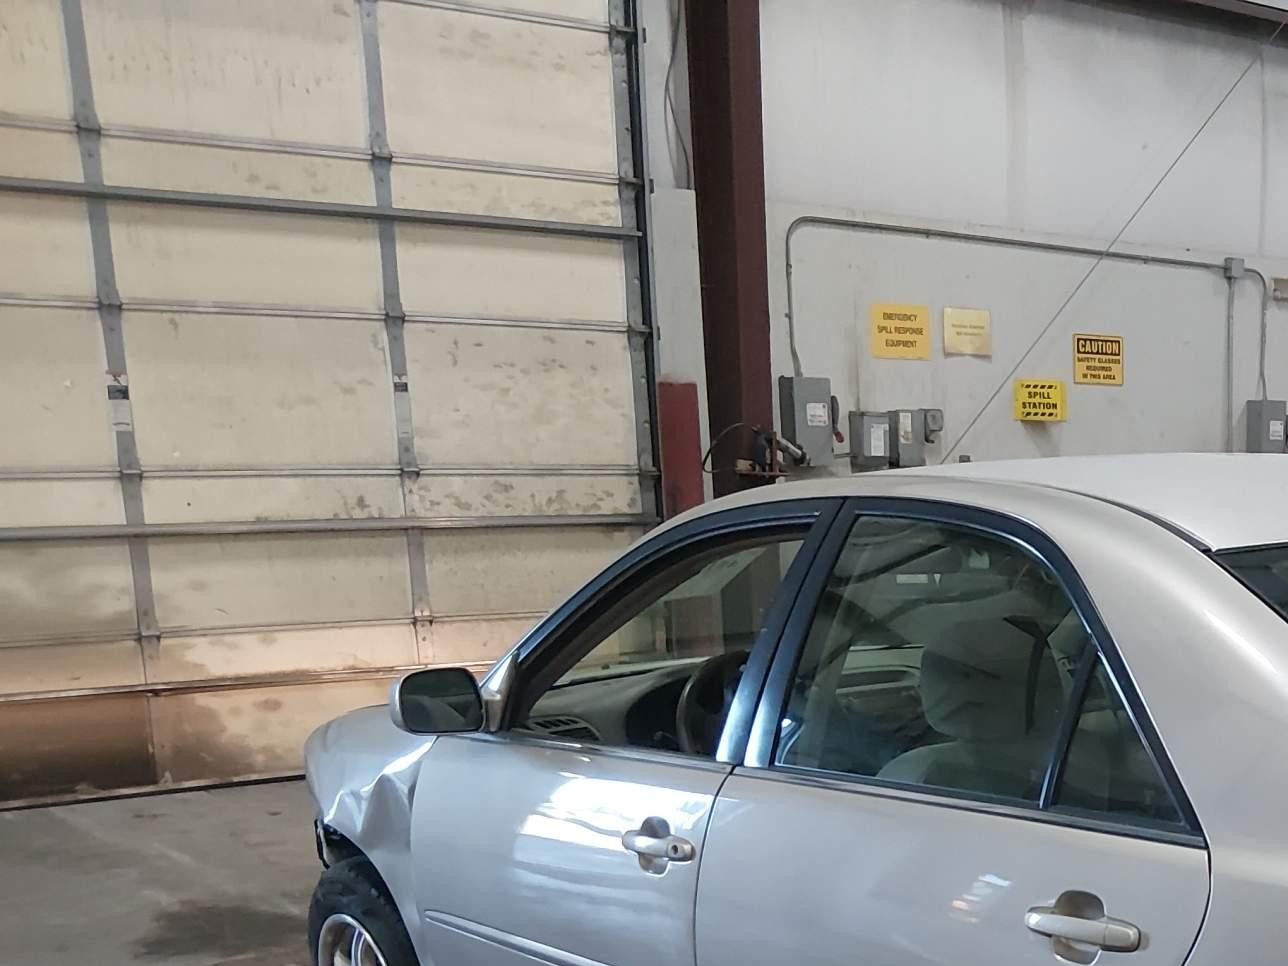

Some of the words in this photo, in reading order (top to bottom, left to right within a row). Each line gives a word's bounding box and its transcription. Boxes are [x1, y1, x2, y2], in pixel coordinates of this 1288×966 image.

[877, 325, 893, 334] SPILL
[894, 326, 924, 336] RESPONSE
[885, 338, 917, 349] EQUIPMENT
[1078, 339, 1119, 355] CAUTION
[1077, 356, 1097, 364] SAFETY
[1098, 357, 1121, 365] GLASSES
[1027, 391, 1052, 400] SPILL
[1021, 401, 1058, 410] STATION
